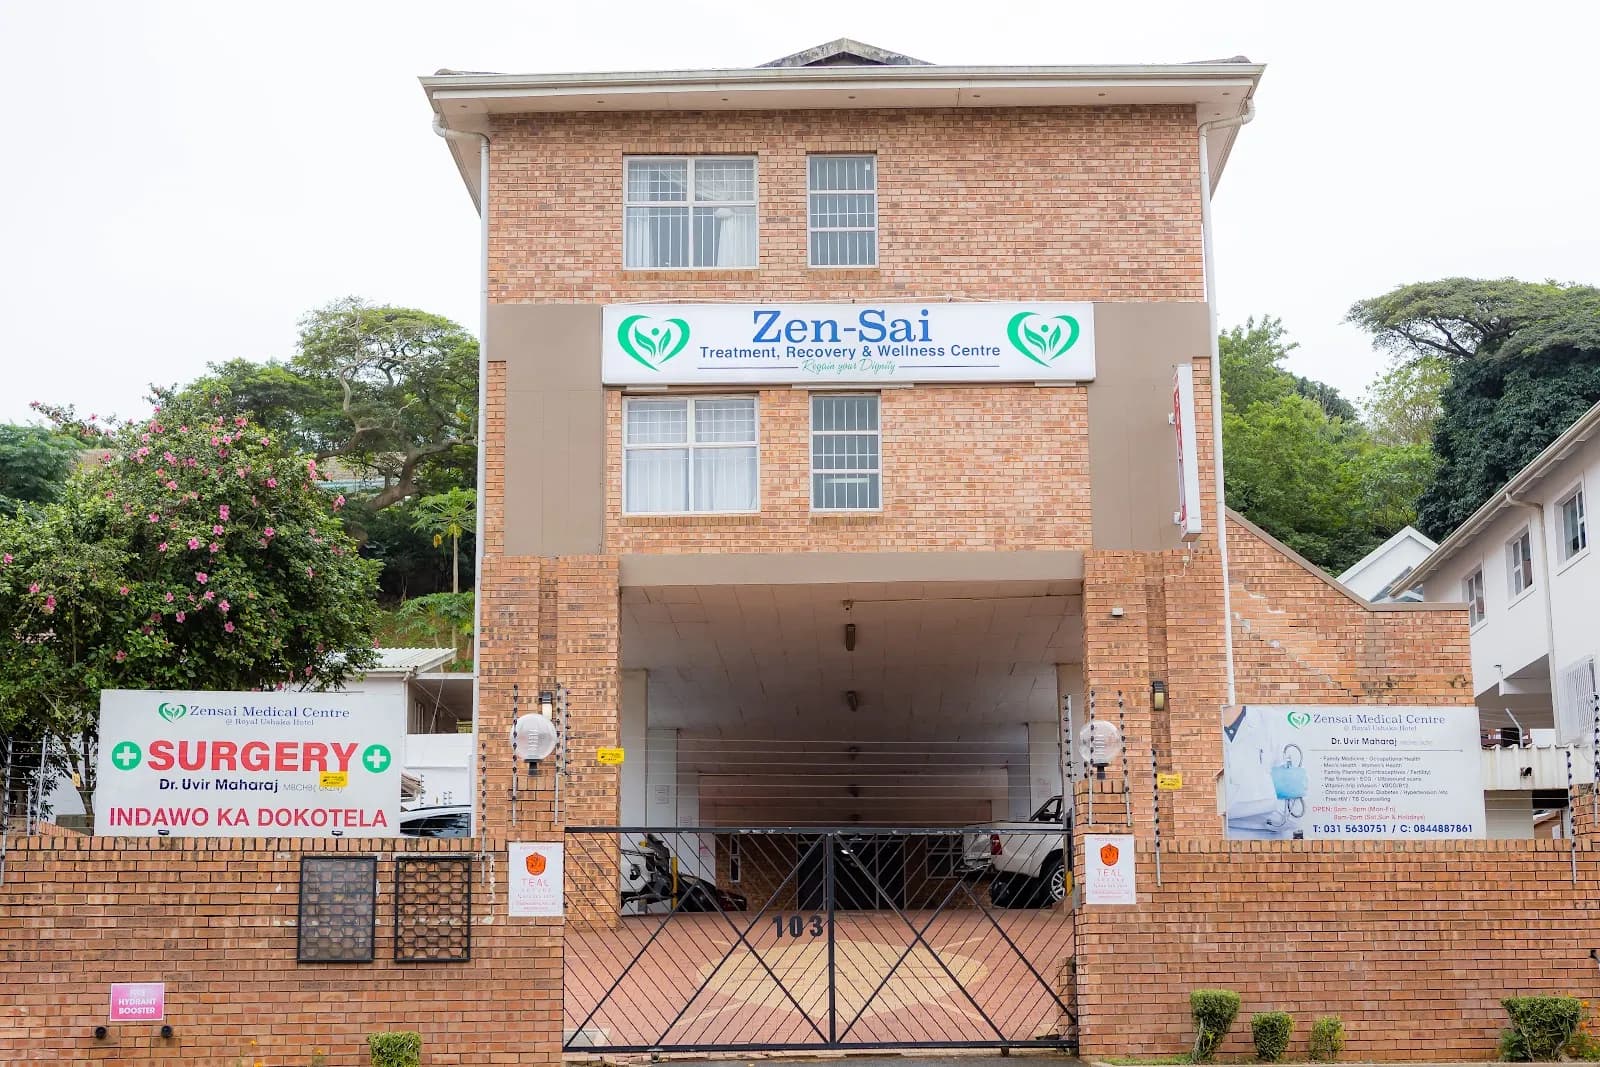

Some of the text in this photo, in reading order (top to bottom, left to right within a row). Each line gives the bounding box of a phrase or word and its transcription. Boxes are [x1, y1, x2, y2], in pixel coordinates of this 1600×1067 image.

[752, 309, 933, 343] Zen-Sai
[700, 344, 1001, 360] Treatment, Recovery & Wellness Centre
[801, 359, 896, 374] Regain your Dignity
[190, 704, 350, 718] Zensai Medical Centre
[235, 718, 259, 727] Royal
[293, 718, 315, 727] Hotel
[1313, 713, 1446, 724] Zensai Medical Centre
[1331, 737, 1342, 745] Dr.
[1343, 737, 1359, 745] Uvir
[1362, 737, 1397, 747] Maharaj
[147, 740, 360, 772] SURGERY
[159, 778, 178, 790] Dr.
[182, 778, 211, 791] Uvir
[215, 778, 279, 793] Maharaj
[109, 807, 388, 828] INDAWO KA DOKOTELA
[1324, 824, 1341, 833] 031
[1345, 824, 1387, 833] 5630751
[1391, 824, 1396, 833] /
[1400, 824, 1411, 833] C:
[1413, 824, 1473, 833] 0844887861
[773, 916, 823, 938] 103
[118, 998, 156, 1006] HYDRANT
[118, 1007, 155, 1015] BOOSTER
